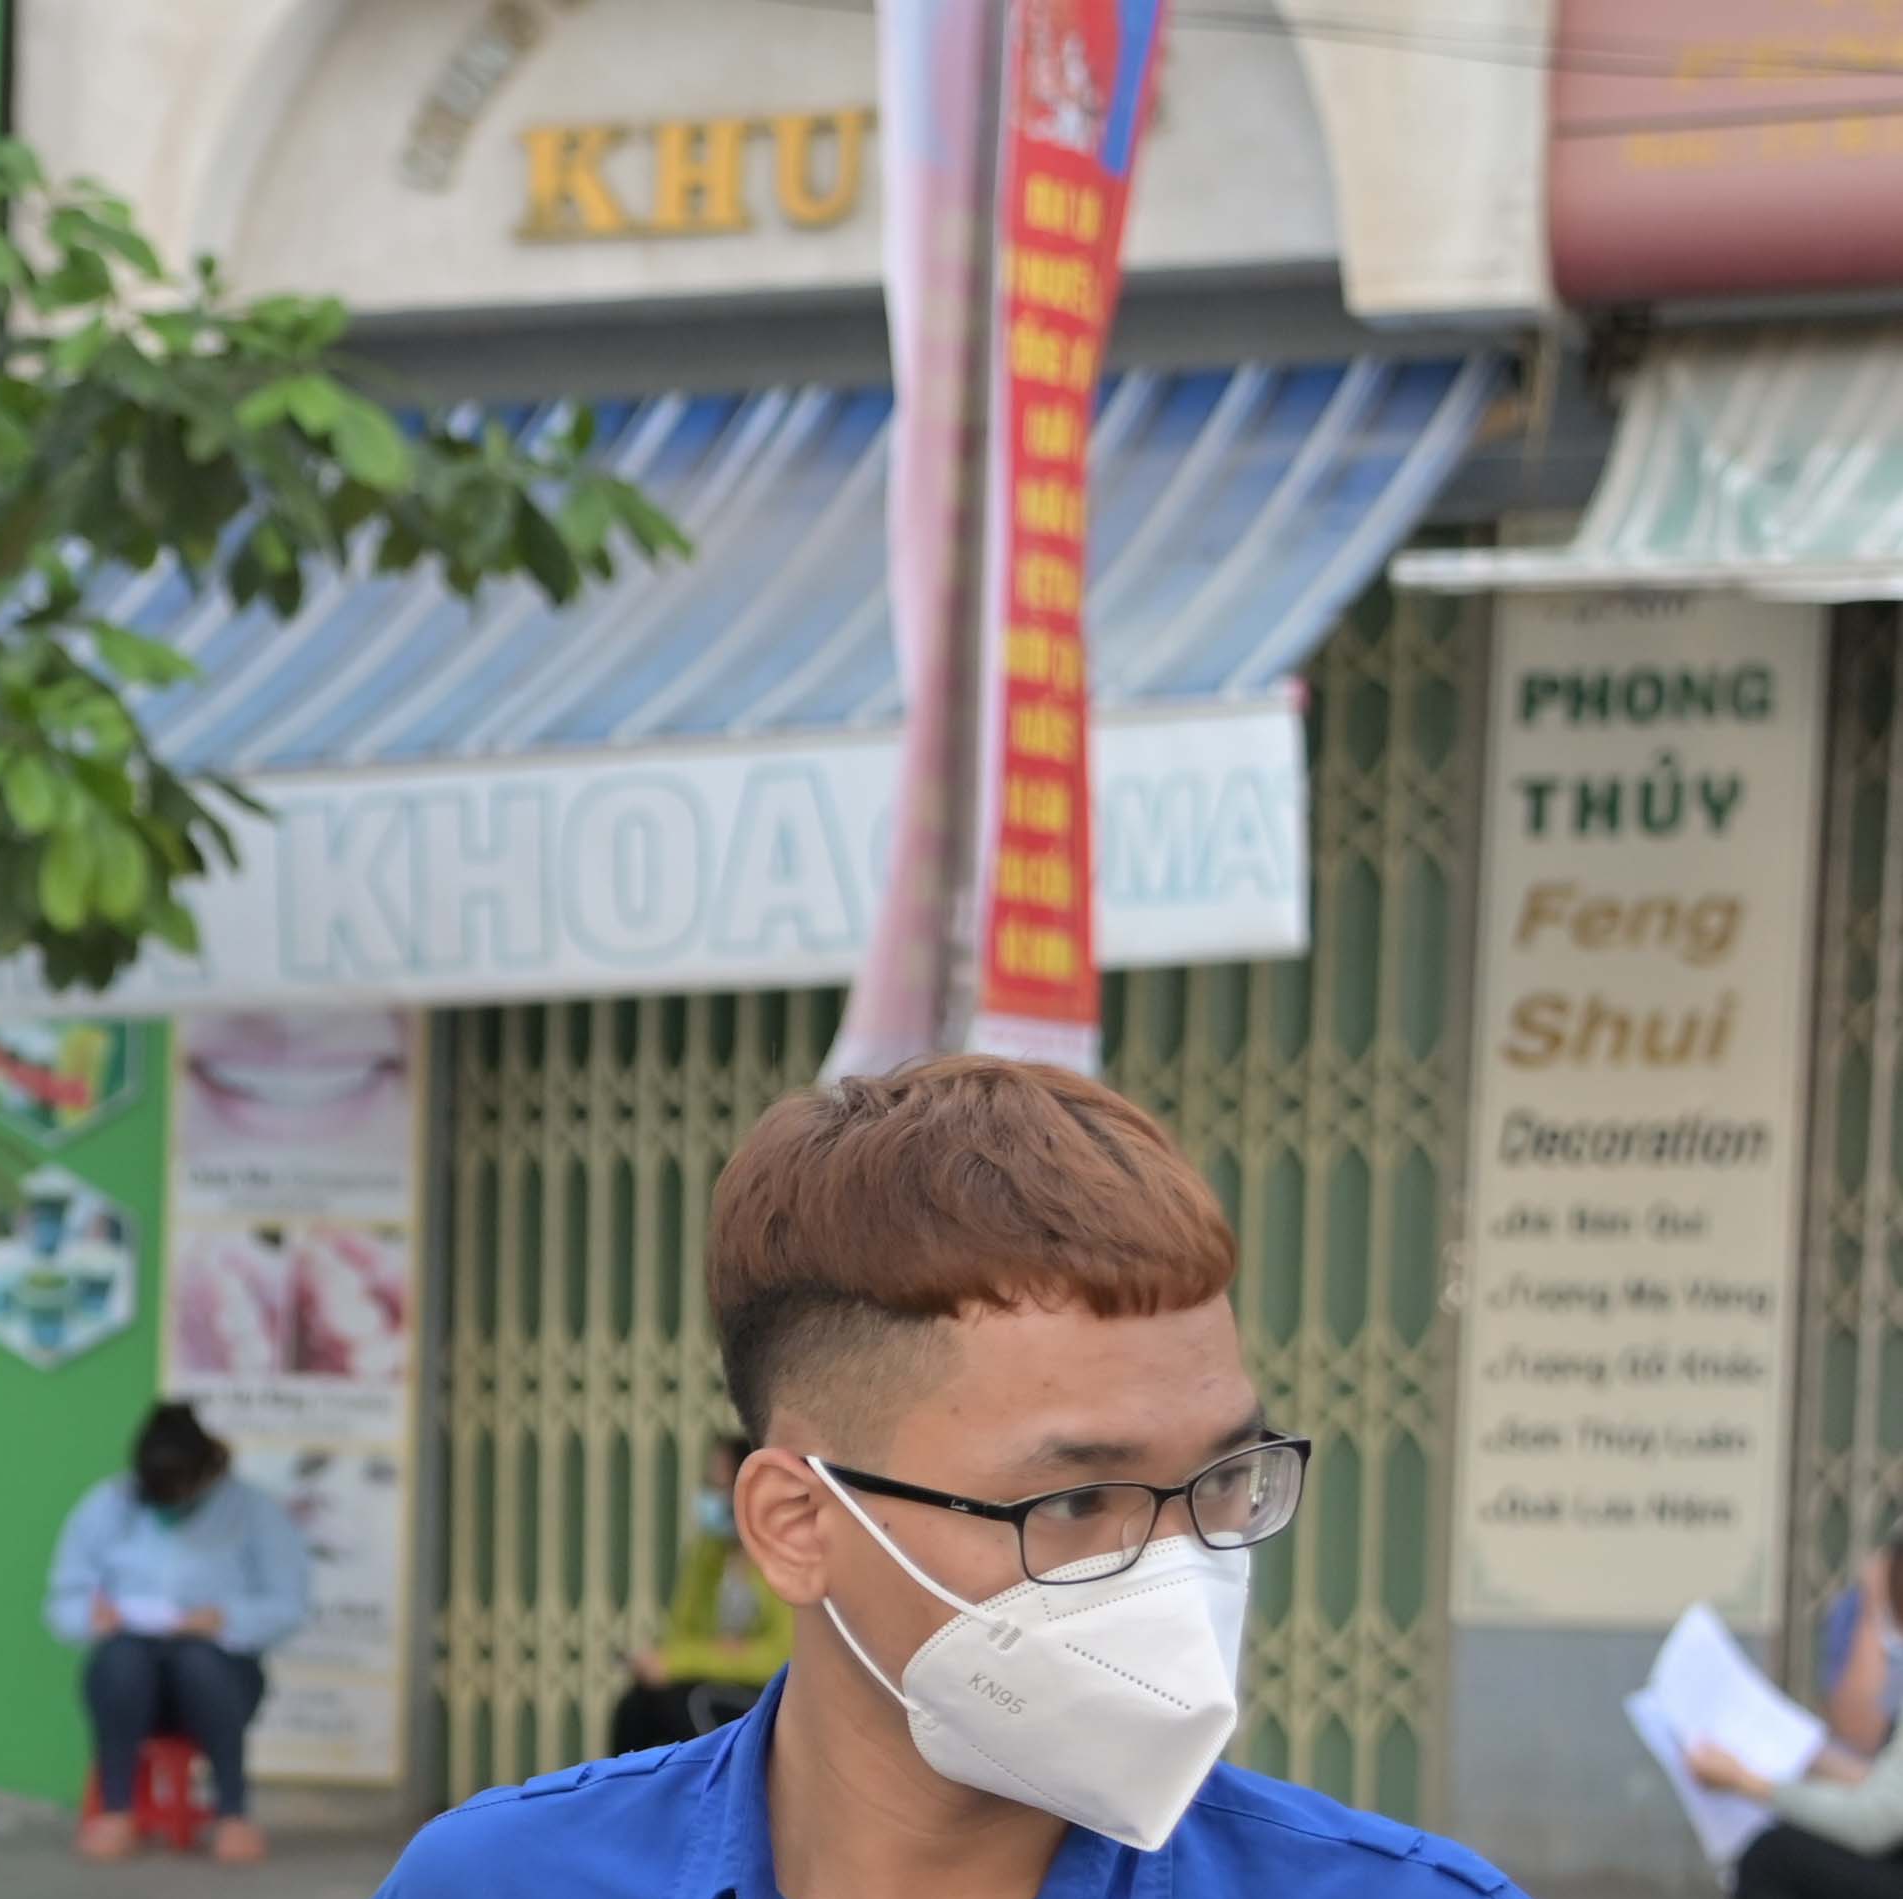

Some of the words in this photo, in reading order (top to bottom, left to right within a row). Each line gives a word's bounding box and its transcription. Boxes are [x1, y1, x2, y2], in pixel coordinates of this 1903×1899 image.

[1517, 662, 1775, 727] PHONG
[1517, 748, 1743, 838] THỦY
[278, 764, 861, 983] KHOA
[1513, 880, 1745, 970] Feng
[1501, 986, 1741, 1072] Shui
[1498, 1107, 1770, 1169] Decoration
[967, 1670, 1029, 1716] KN95
